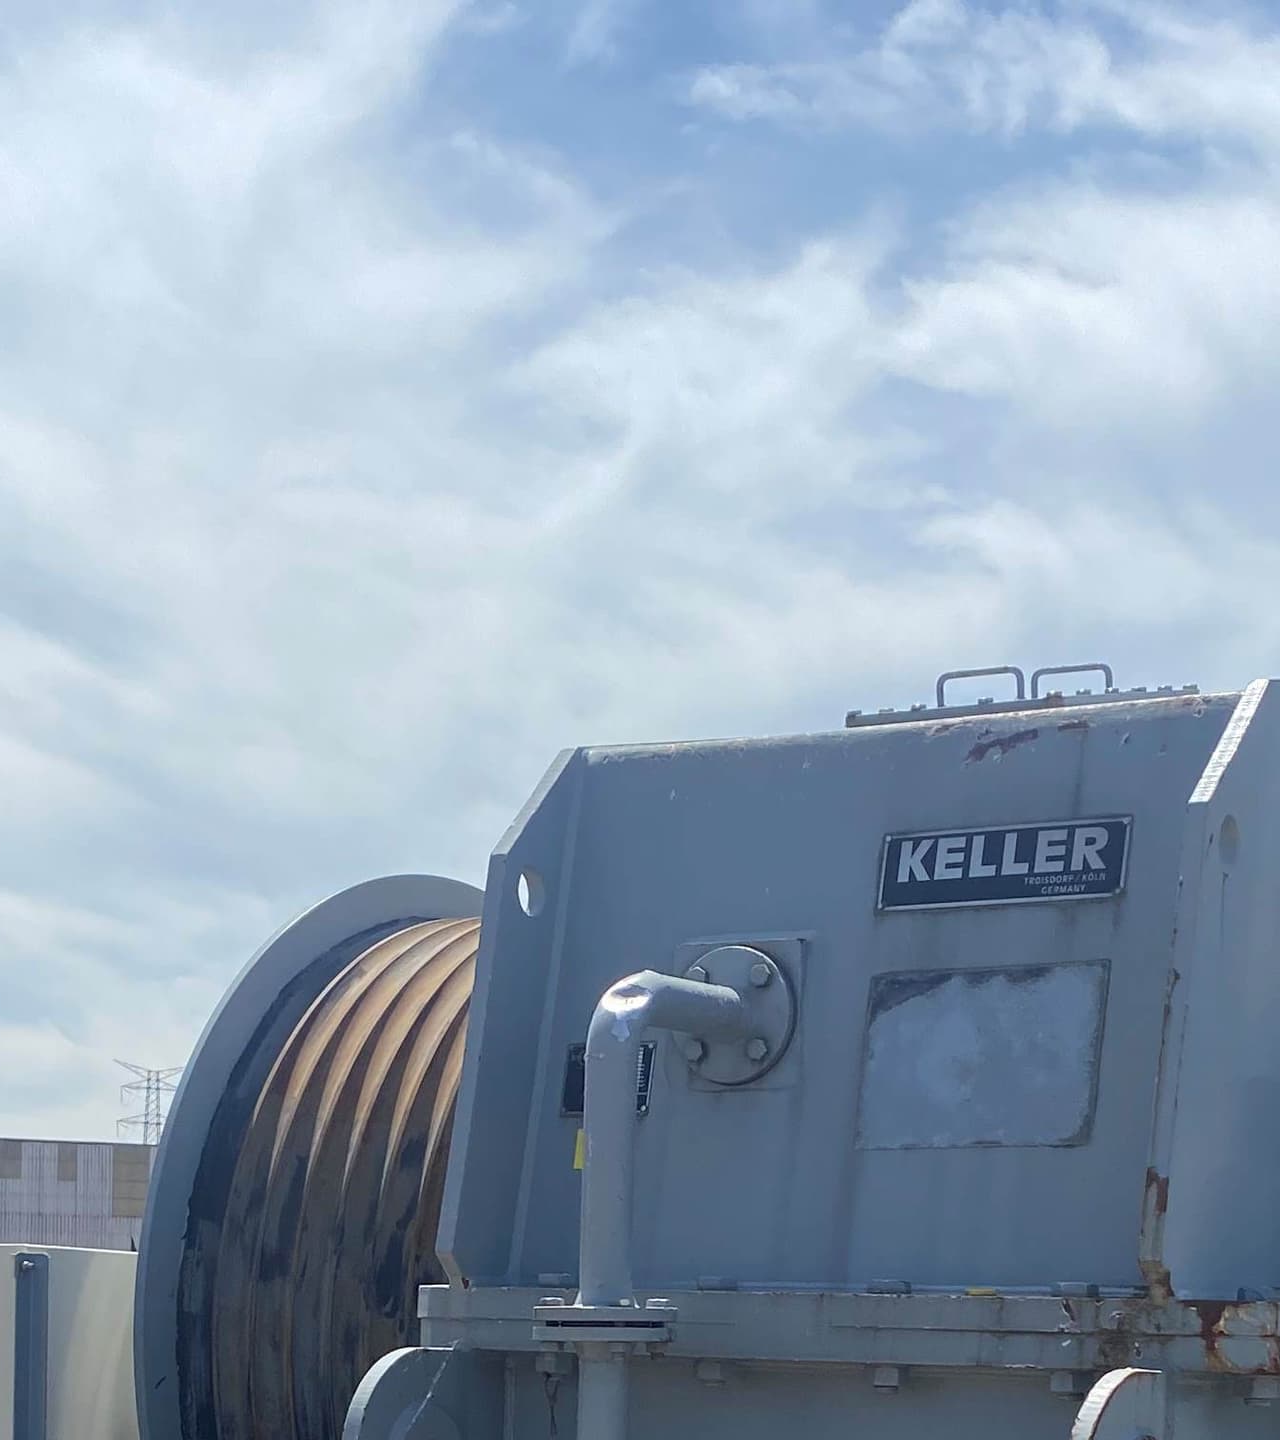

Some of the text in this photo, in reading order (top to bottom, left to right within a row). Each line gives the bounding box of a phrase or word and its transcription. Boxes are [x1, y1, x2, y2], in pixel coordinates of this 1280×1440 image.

[897, 826, 1109, 883] KELLER
[1081, 872, 1106, 883] KÖLN
[1041, 884, 1086, 895] GERMANY
